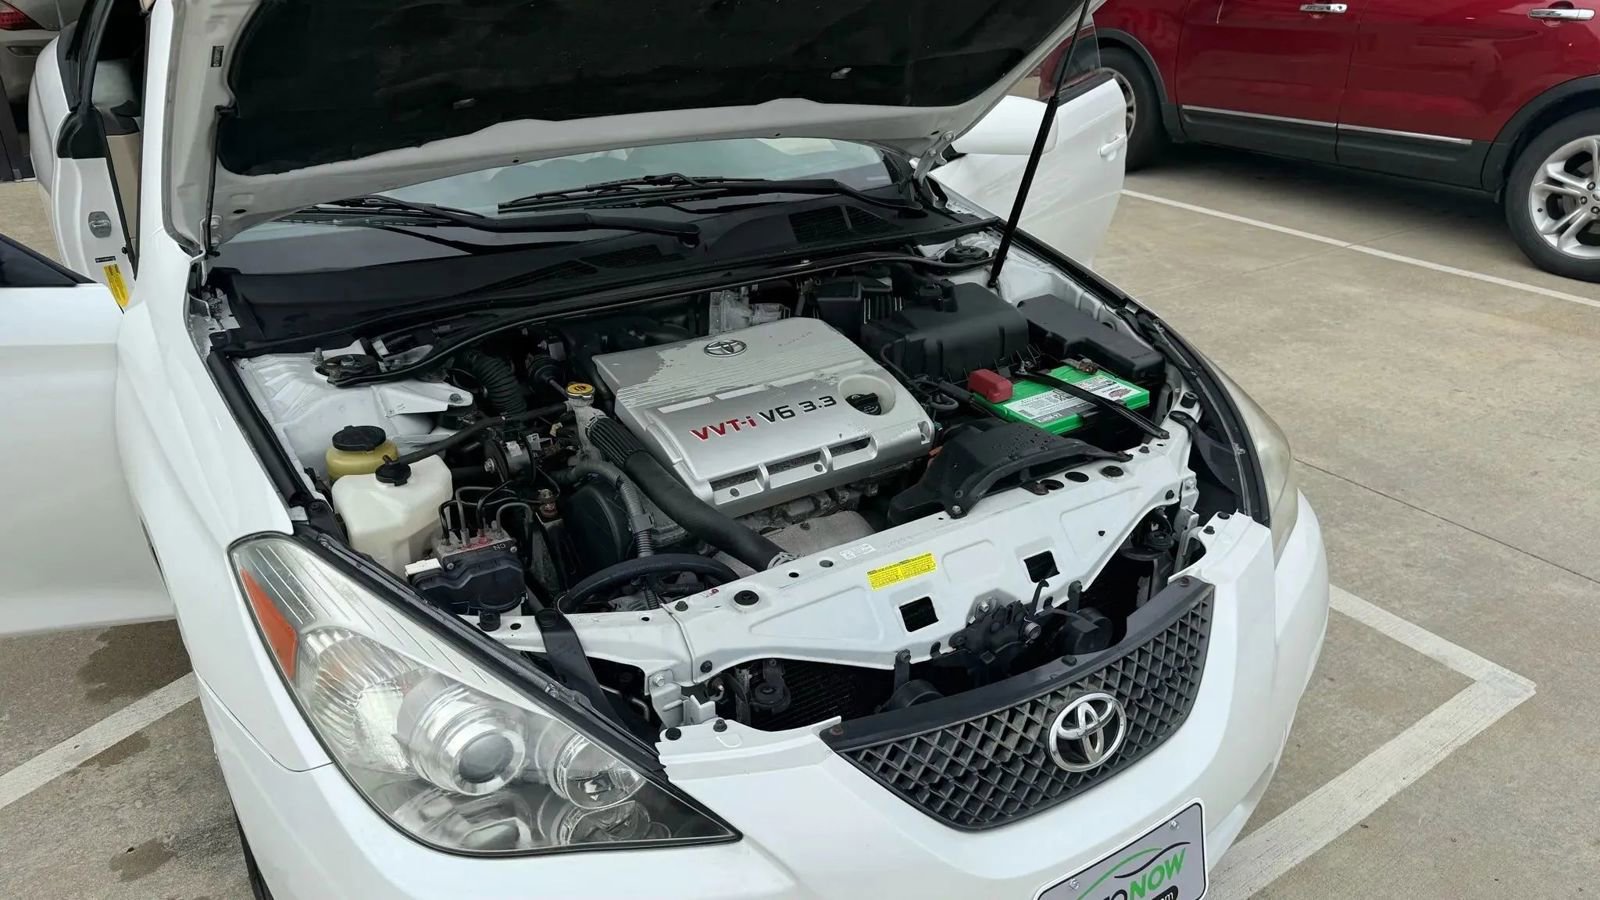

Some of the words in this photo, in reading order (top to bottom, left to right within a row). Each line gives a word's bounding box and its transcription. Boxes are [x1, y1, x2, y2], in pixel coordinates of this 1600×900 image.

[689, 415, 757, 441] VVT-i
[757, 405, 796, 424] V6
[798, 395, 837, 413] 3.3
